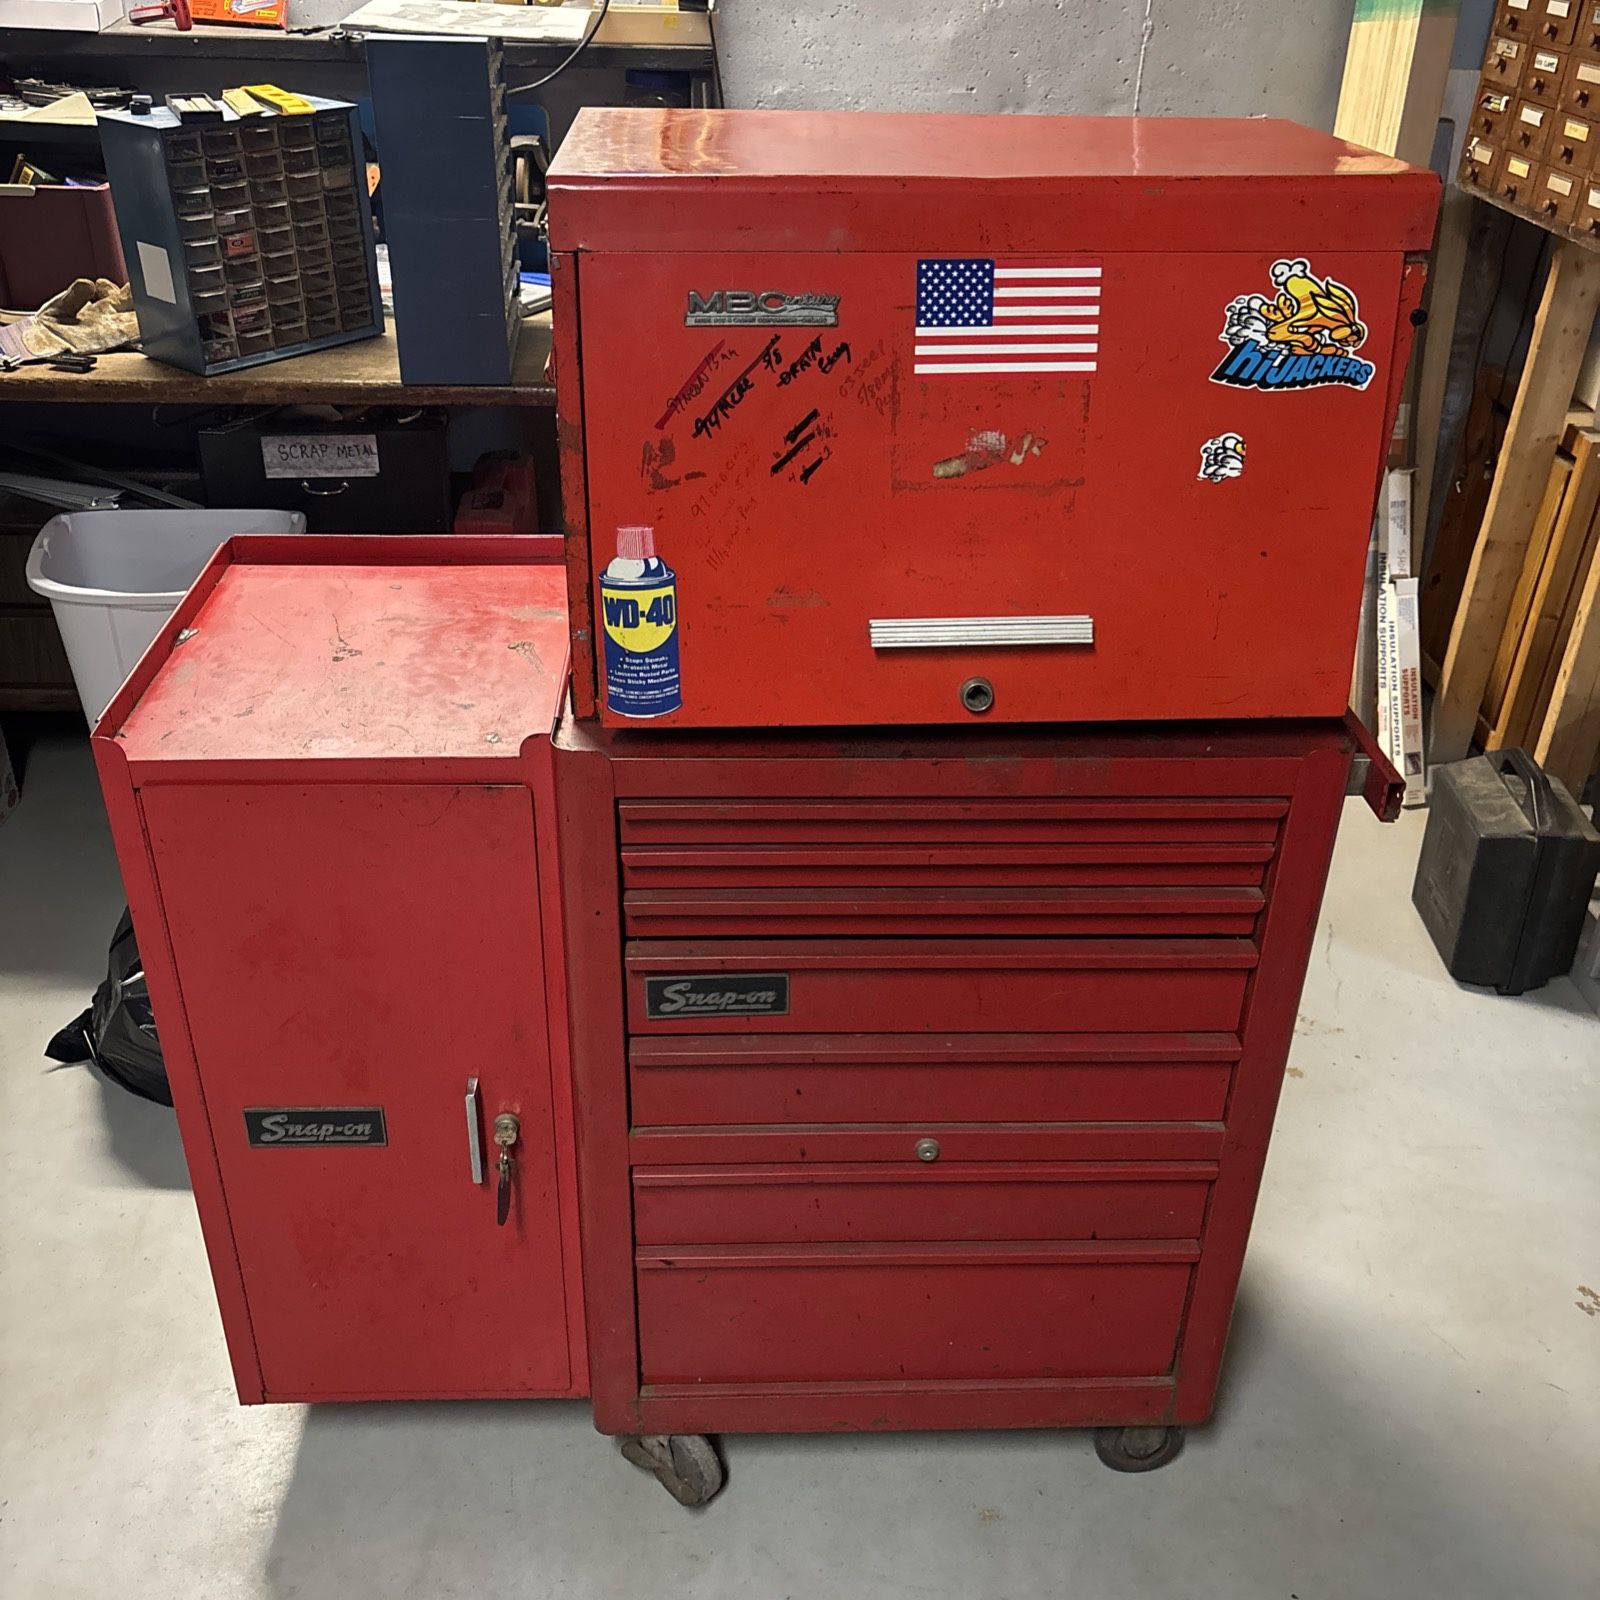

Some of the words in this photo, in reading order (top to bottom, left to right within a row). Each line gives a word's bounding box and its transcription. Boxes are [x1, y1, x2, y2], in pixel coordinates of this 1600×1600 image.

[277, 443, 328, 461] SCRAP
[336, 444, 378, 459] METAL
[603, 594, 674, 629] WD-40
[1379, 552, 1388, 624] INSULATION
[651, 662, 668, 670] Metal
[1379, 627, 1388, 689] SUPPORTS
[1388, 620, 1399, 692] INSULATION
[1401, 668, 1411, 716] SUPPORTS
[1410, 667, 1419, 720] INSULATION
[1392, 695, 1401, 757] SUPPORTS
[659, 982, 777, 1013] Snap-on
[260, 1113, 373, 1142] Snap-on
